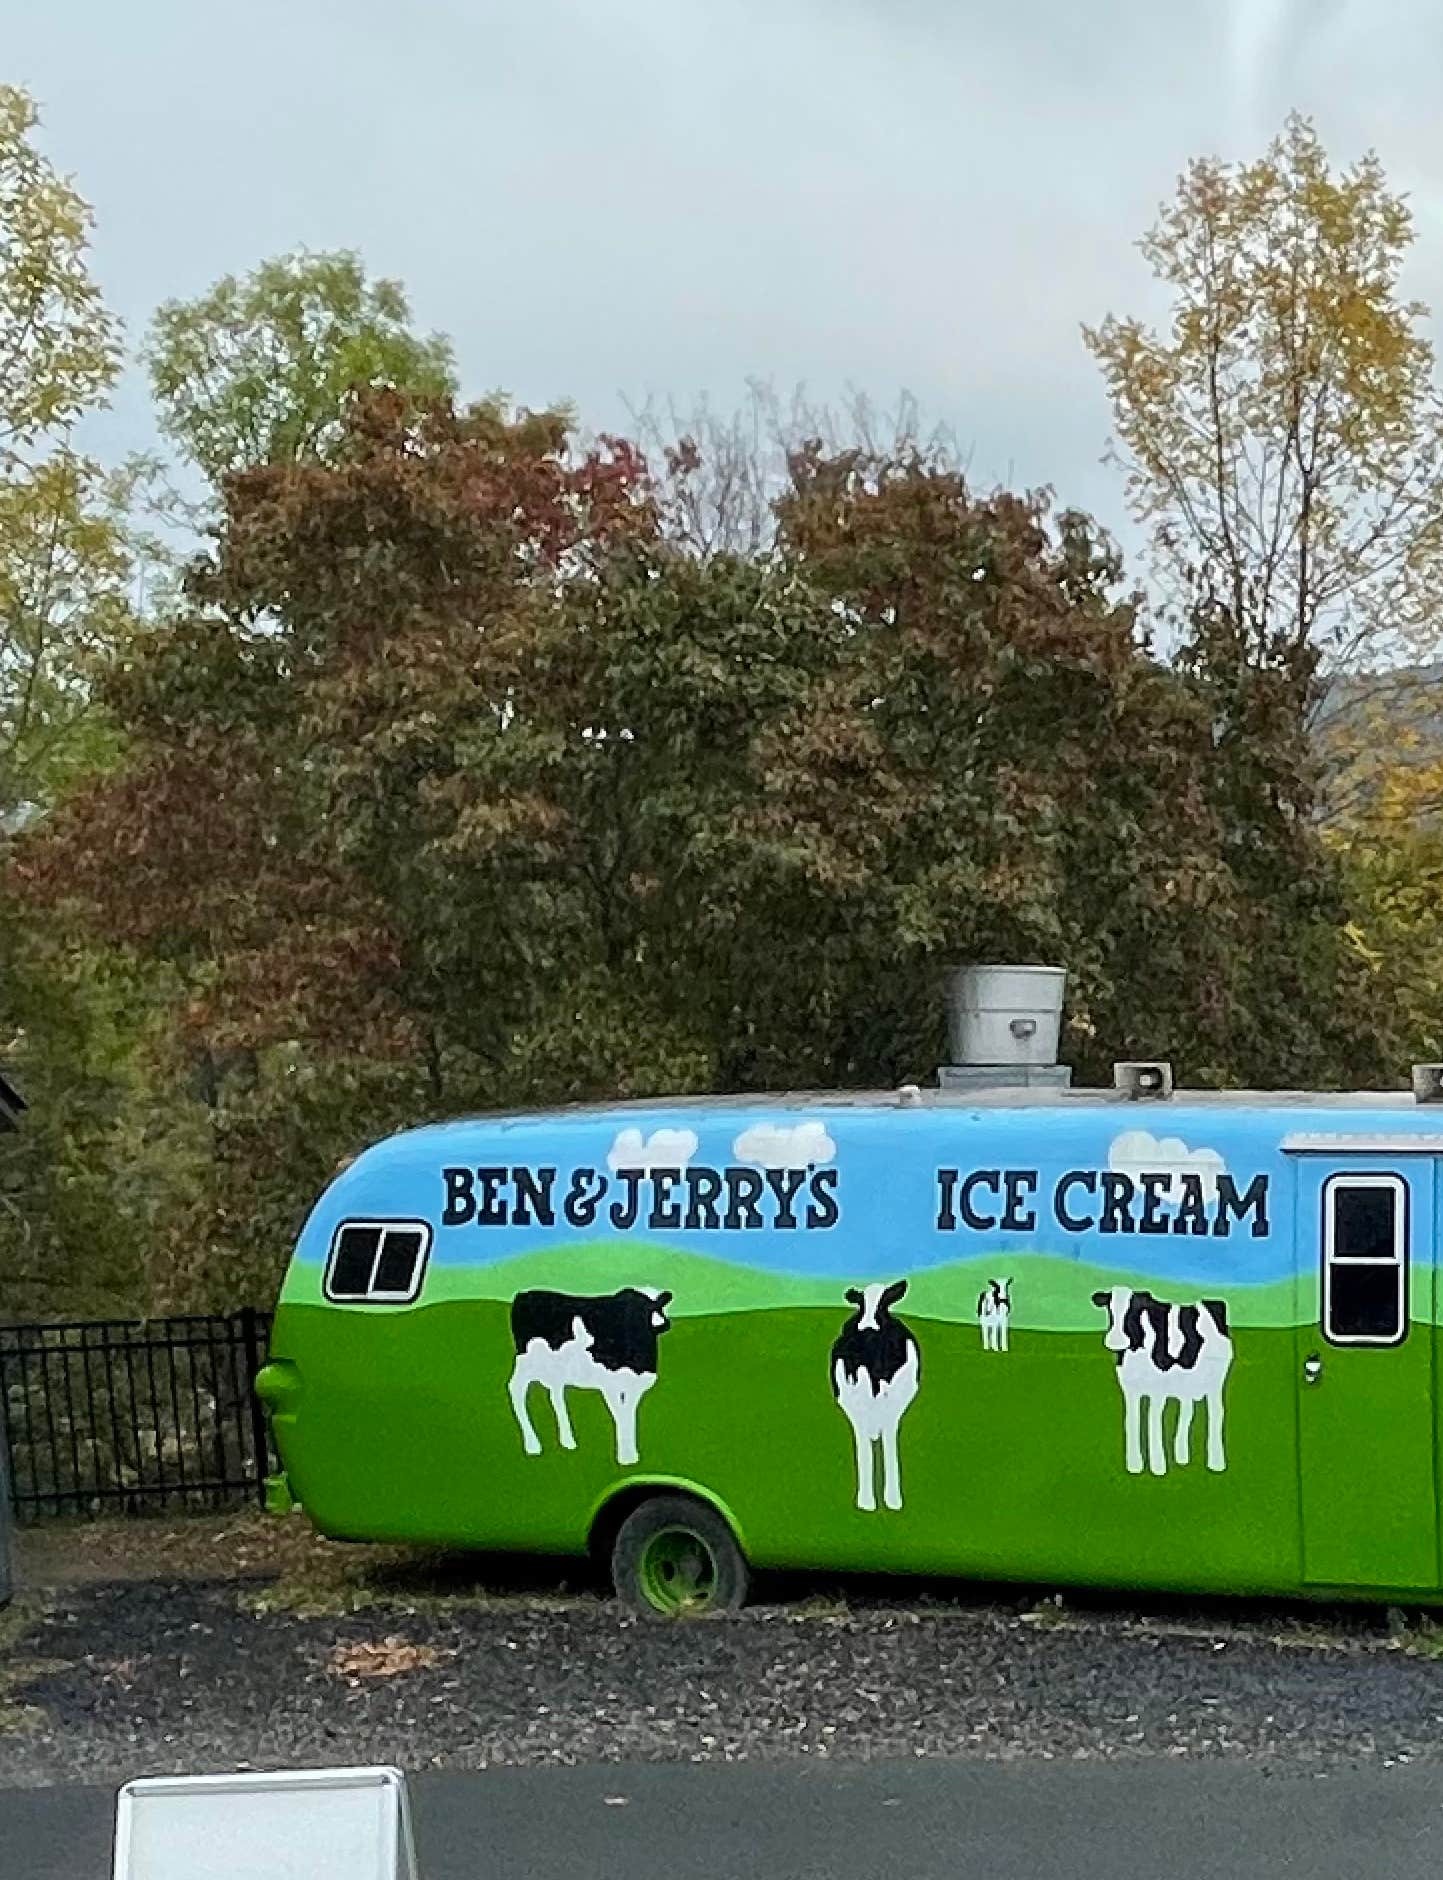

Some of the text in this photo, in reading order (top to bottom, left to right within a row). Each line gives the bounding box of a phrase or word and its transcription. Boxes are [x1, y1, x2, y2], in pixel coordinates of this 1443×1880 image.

[609, 1163, 839, 1230] JERRY'S
[937, 1170, 1270, 1238] ICE CREAM
